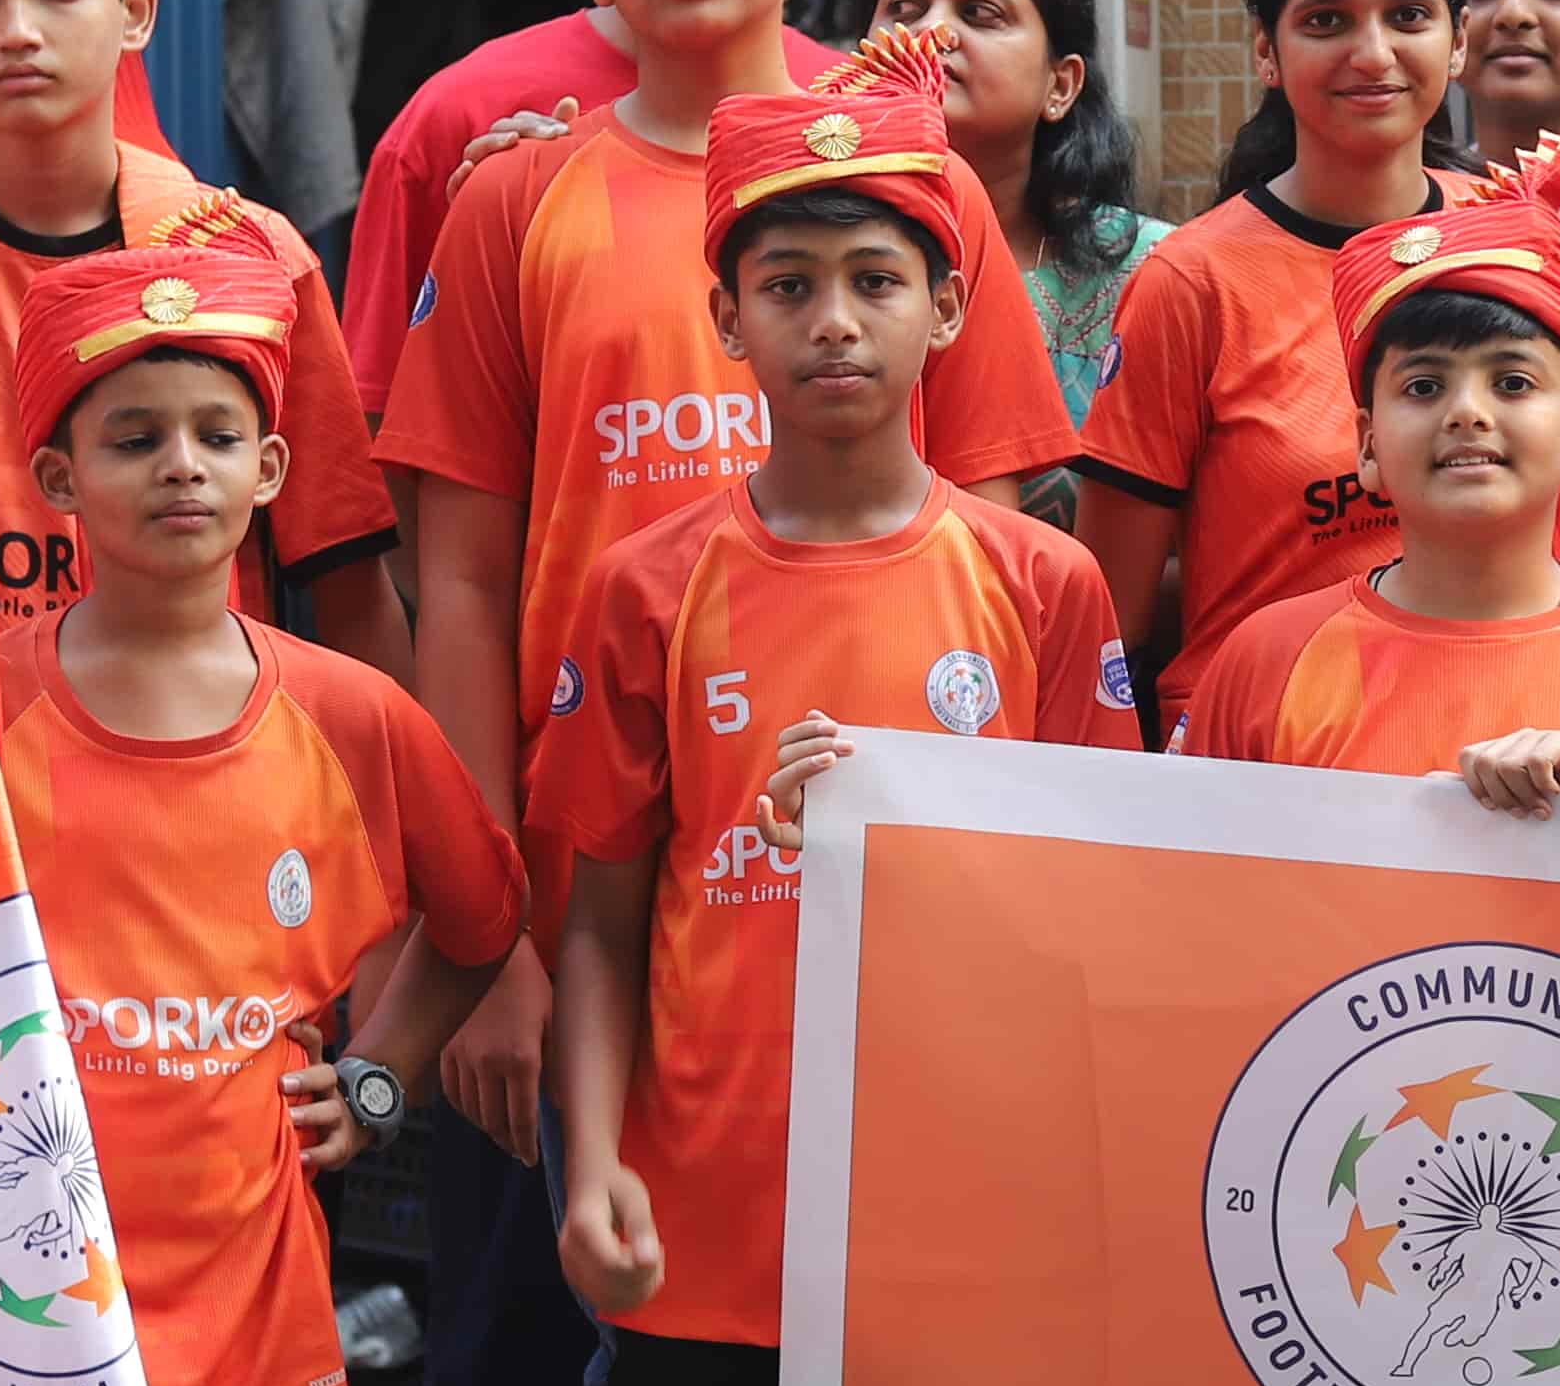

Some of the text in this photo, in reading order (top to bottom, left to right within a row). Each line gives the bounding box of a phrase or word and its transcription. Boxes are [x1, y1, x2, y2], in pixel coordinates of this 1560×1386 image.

[594, 388, 773, 464] SPOR
[647, 457, 711, 485] Little
[705, 670, 751, 735] 5
[703, 887, 745, 906] The
[61, 995, 276, 1053] PORKO
[84, 1052, 147, 1075] Little
[156, 1057, 196, 1082] Big
[1226, 1187, 1256, 1214] 20
